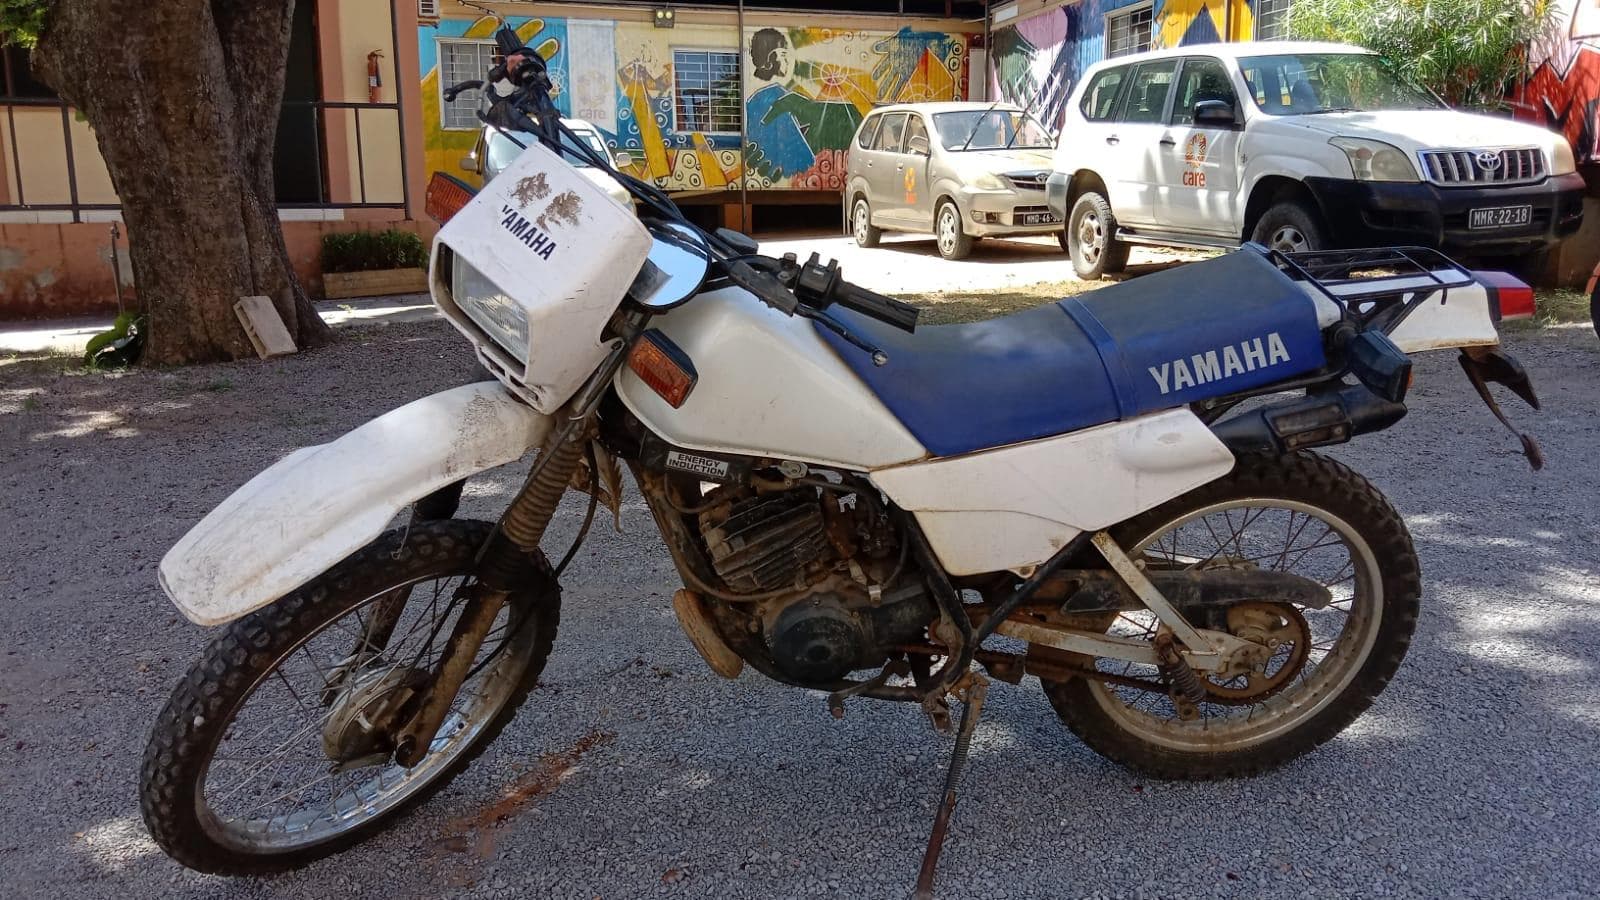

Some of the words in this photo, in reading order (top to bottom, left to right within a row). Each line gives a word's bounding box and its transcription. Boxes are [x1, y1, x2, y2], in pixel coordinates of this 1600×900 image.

[1183, 171, 1205, 187] care
[1474, 208, 1528, 226] MMR-22-18
[1148, 332, 1291, 395] YAMAHA
[668, 458, 725, 476] INDUCTION
[678, 453, 721, 468] ENERGY
